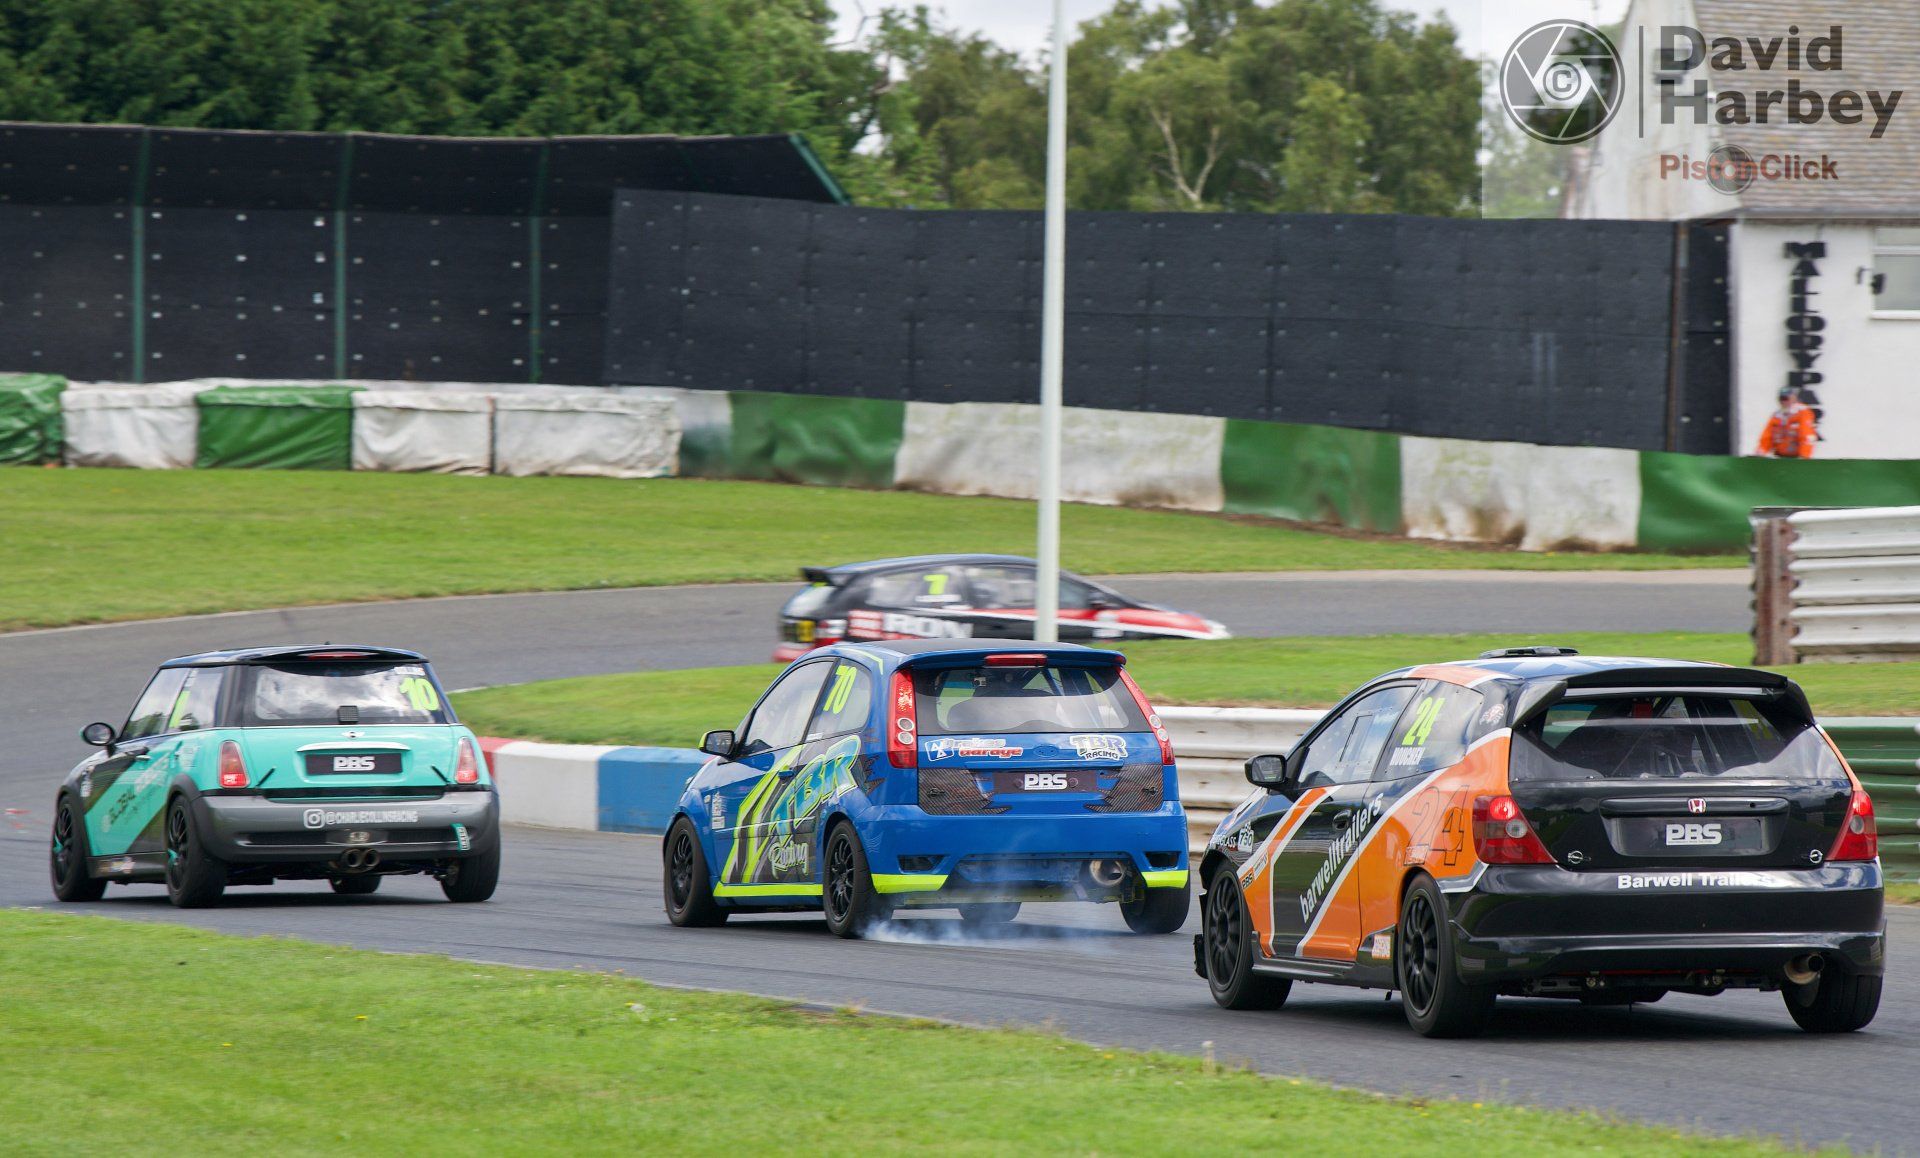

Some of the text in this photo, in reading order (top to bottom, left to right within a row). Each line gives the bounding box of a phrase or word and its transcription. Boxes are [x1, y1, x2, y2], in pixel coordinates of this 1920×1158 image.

[923, 574, 948, 595] 7
[400, 677, 439, 711] 10
[824, 665, 857, 714] 70
[1402, 696, 1446, 746] 24
[1069, 736, 1129, 758] TBR
[1085, 751, 1119, 760] RACING
[333, 756, 375, 771] PBS
[1024, 774, 1068, 790] PBS
[1405, 785, 1469, 866] 24
[1666, 823, 1722, 845] PBS
[767, 841, 809, 879] Racing
[1300, 793, 1384, 924] barwelltrailers
[1618, 873, 1693, 889] Barwell
